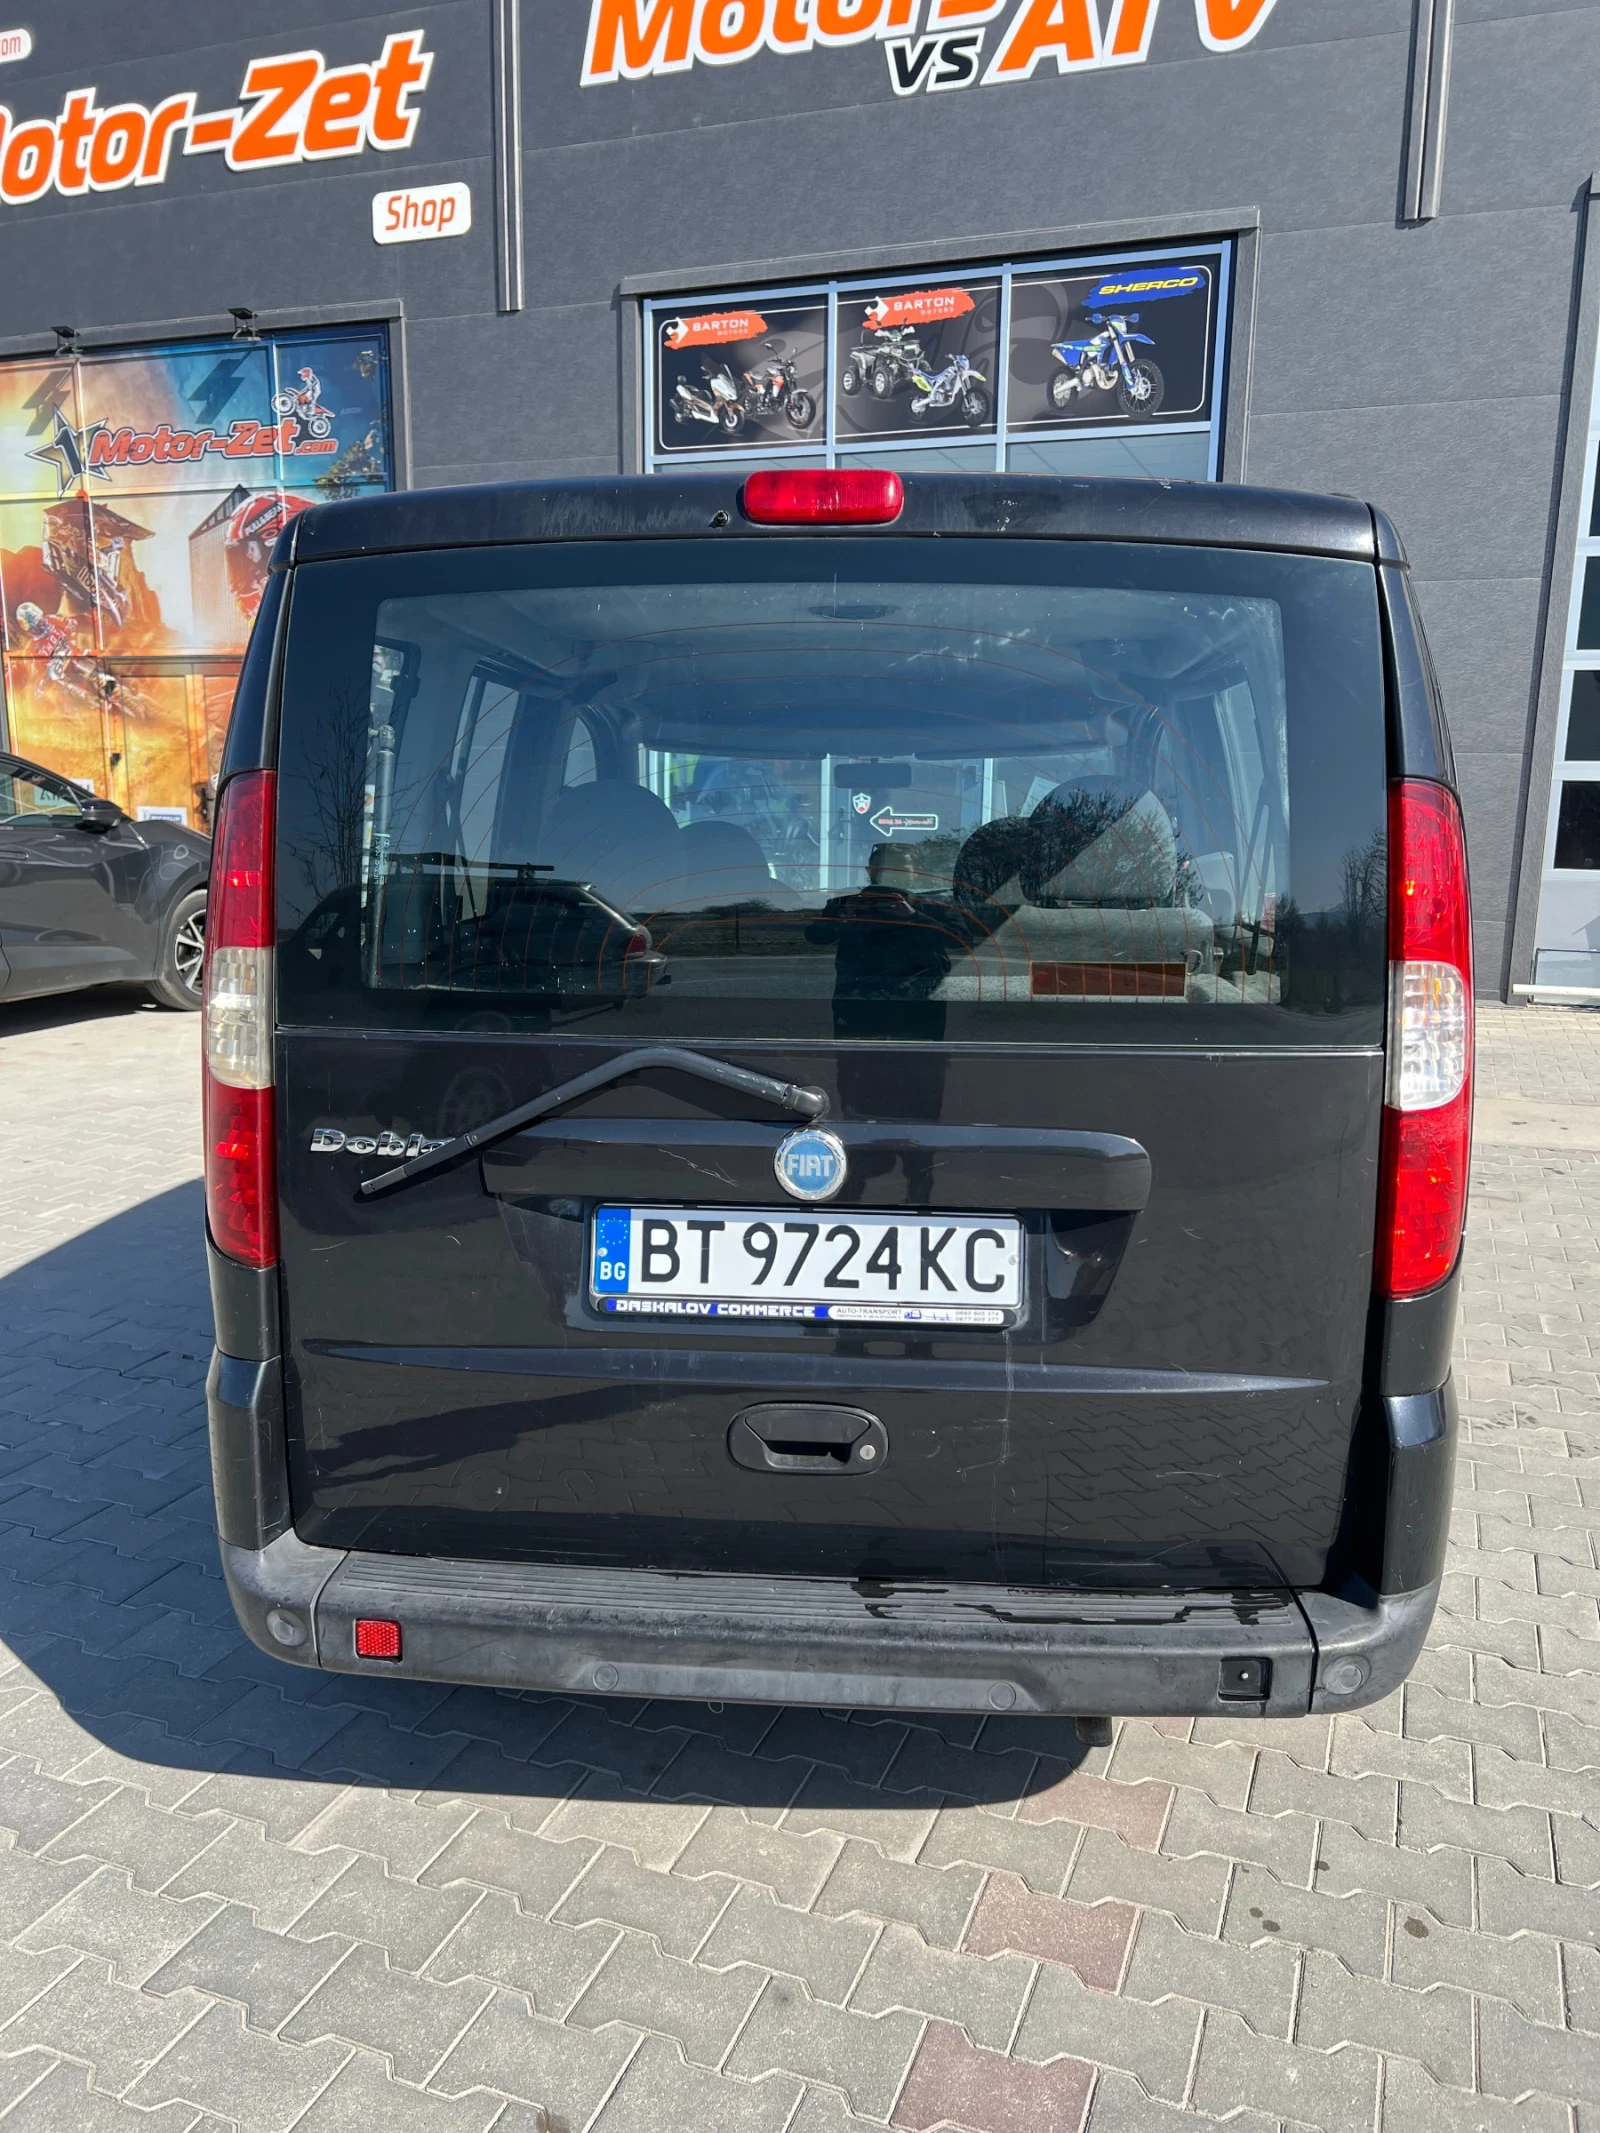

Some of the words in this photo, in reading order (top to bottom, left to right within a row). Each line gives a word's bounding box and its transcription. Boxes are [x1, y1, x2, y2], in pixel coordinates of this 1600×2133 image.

[0, 36, 432, 201] otor-Zet
[384, 194, 456, 233] Shop
[1098, 277, 1199, 295] SHERCO
[892, 296, 955, 312] BARTON
[920, 306, 955, 316] MOTORS
[692, 318, 749, 332] BARTON
[717, 328, 749, 336] MOTORS
[786, 1153, 834, 1177] FIAT
[641, 1218, 726, 1284] BT
[742, 1221, 902, 1291] 9724
[919, 1226, 1006, 1293] KC
[599, 1261, 626, 1281] BG
[615, 1299, 711, 1316] DASKALOV
[716, 1303, 816, 1318] COMMERCE
[836, 1307, 902, 1315] AUTO-TRANSPORT
